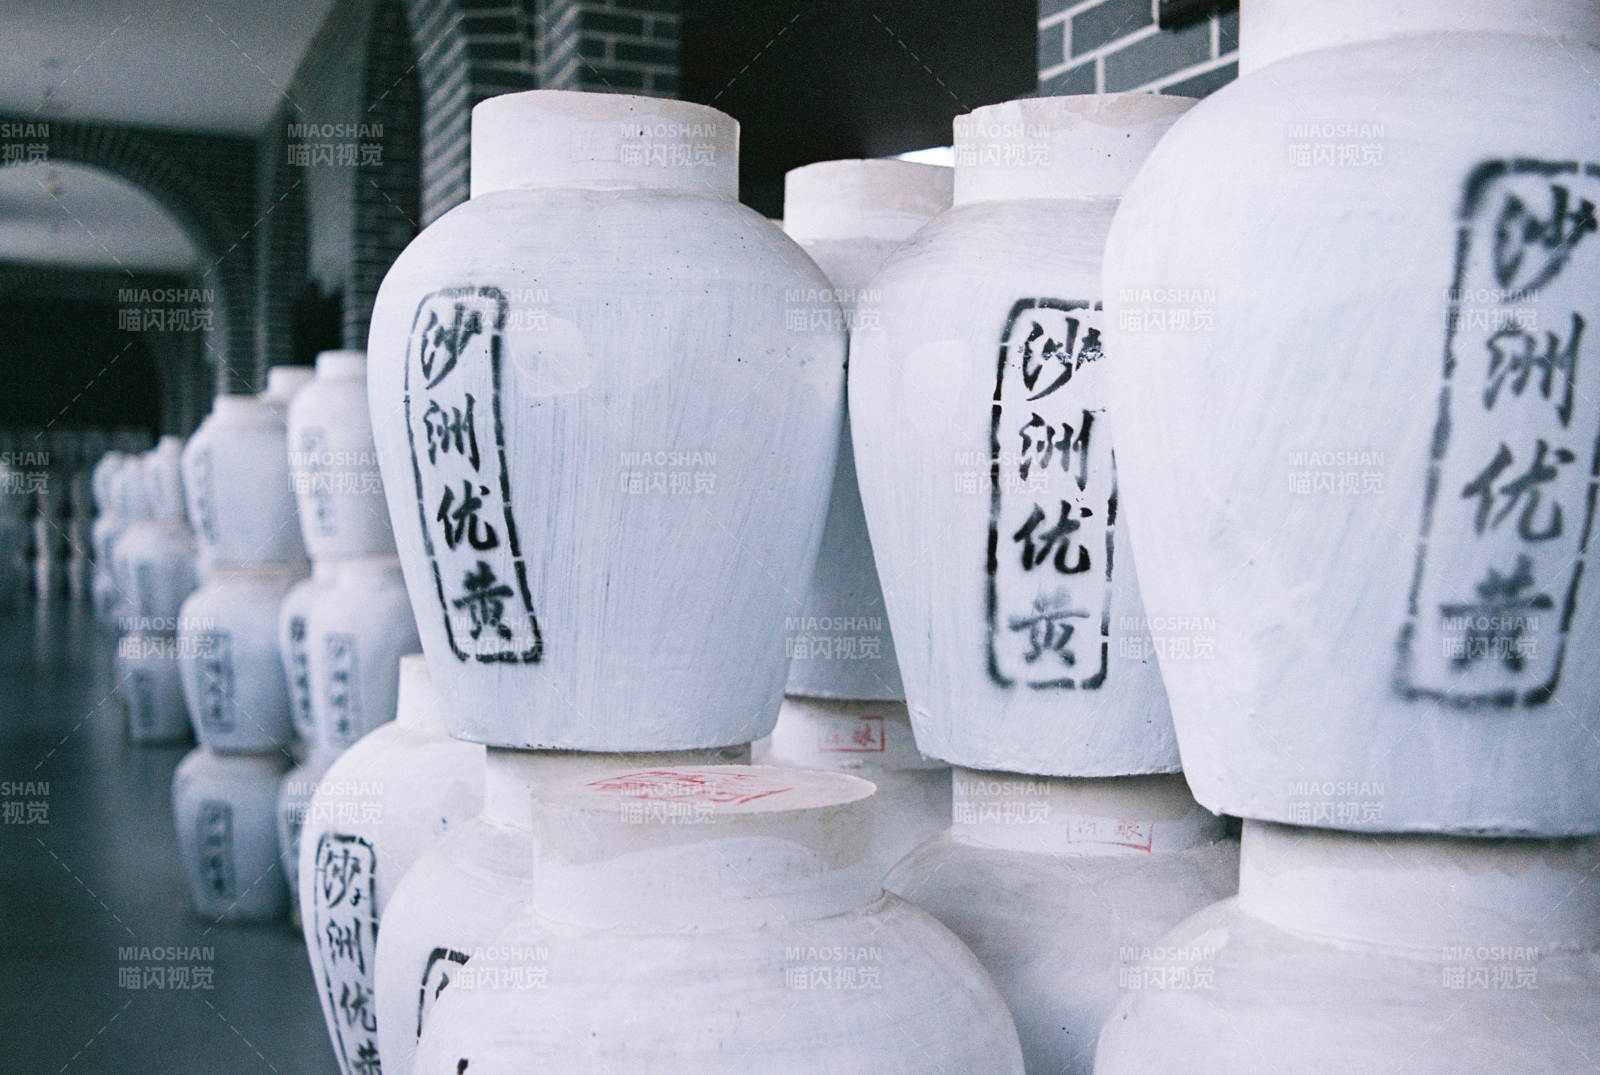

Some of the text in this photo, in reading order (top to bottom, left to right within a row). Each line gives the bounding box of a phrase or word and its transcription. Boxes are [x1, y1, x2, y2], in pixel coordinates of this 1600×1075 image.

[421, 303, 514, 640] 沙洲优黄
[1009, 318, 1103, 666] 沙洲优黄
[1439, 184, 1599, 672] 沙洲优黄
